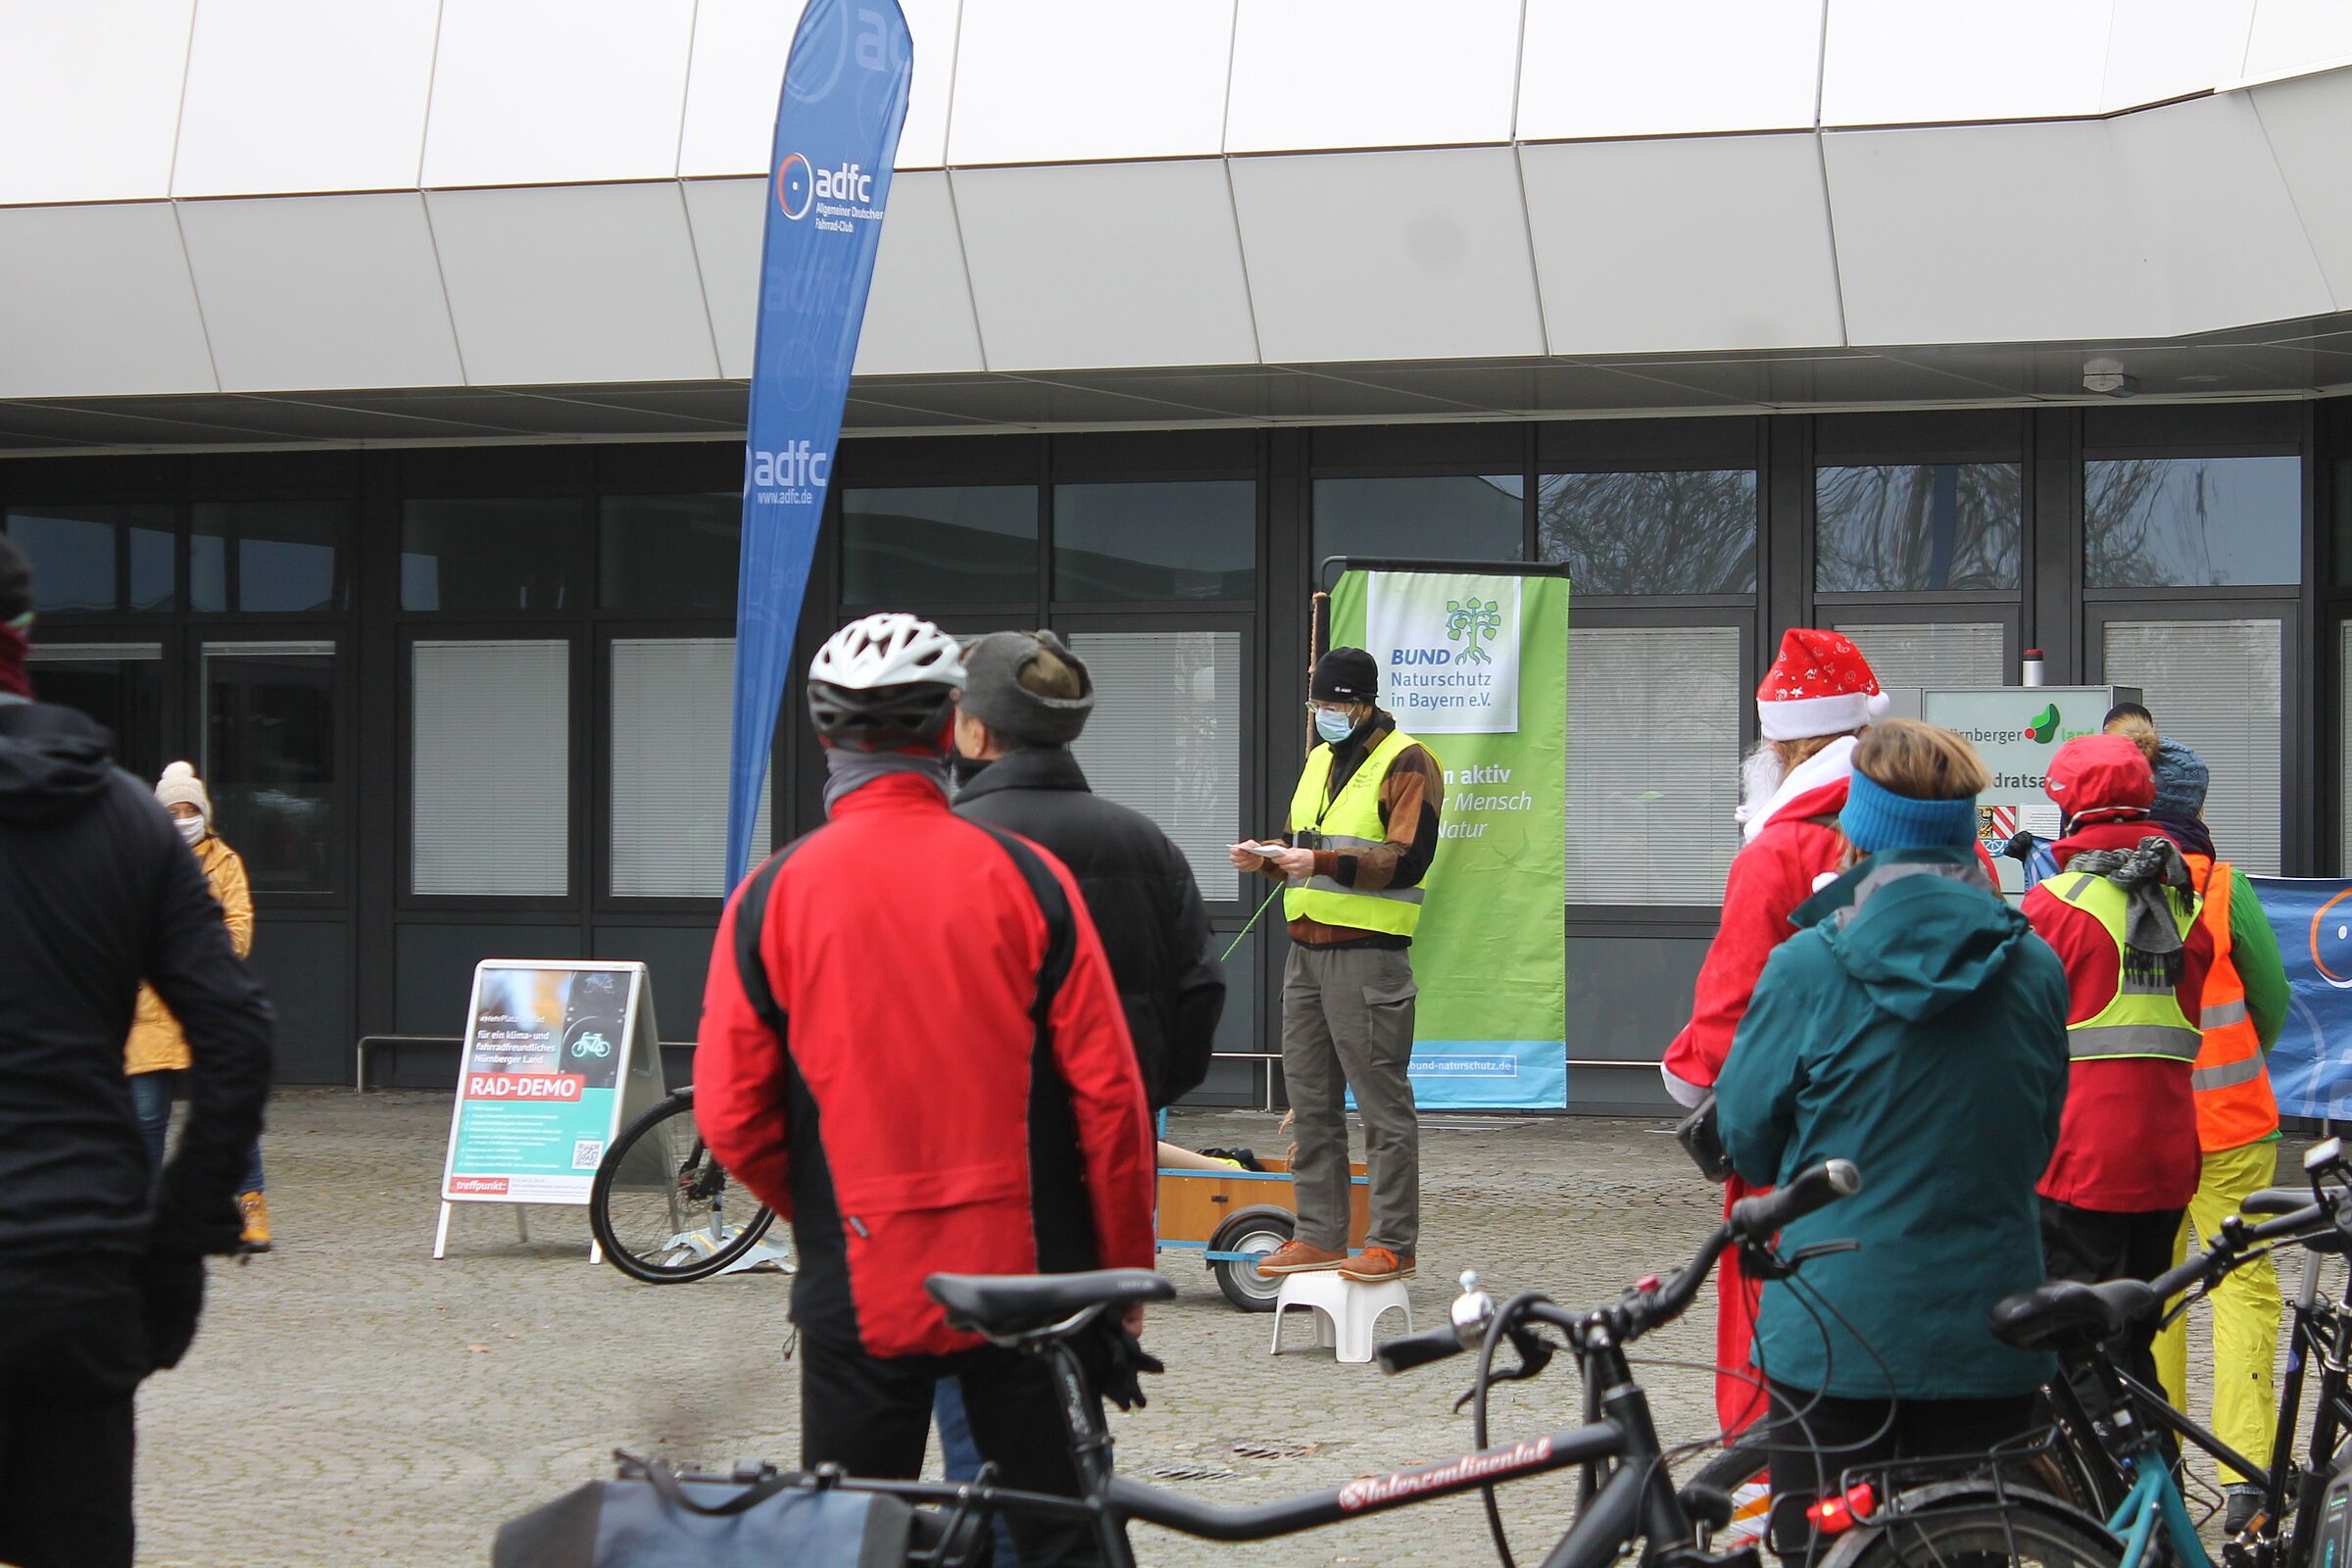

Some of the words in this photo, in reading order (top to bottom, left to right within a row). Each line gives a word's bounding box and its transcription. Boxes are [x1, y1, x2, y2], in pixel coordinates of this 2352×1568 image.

[815, 162, 871, 203] adfc
[815, 202, 851, 217] Allgemeiner
[851, 206, 883, 220] Deutscher
[815, 218, 854, 232] Fahrrad-Club
[755, 440, 826, 486] adfc
[758, 489, 812, 504] www.adfc.de
[1391, 649, 1450, 665] BUND
[1392, 671, 1492, 687] Naturschutz
[1392, 692, 1404, 707] in
[1409, 692, 1464, 710] Bayern
[1469, 692, 1492, 707] e.V.
[1460, 764, 1511, 784] aktiv
[1993, 772, 2046, 788] dratsa
[1453, 791, 1532, 811] Mensch
[477, 1030, 490, 1039] für
[491, 1031, 505, 1040] ein
[506, 1030, 532, 1040] klima-
[533, 1031, 550, 1041] und
[476, 1042, 557, 1053] fahrradfreundliches
[474, 1054, 521, 1065] Nürnberger
[523, 1055, 544, 1064] Land
[470, 1077, 576, 1098] RAD-DEMO
[456, 1180, 507, 1192] treffpunkt:
